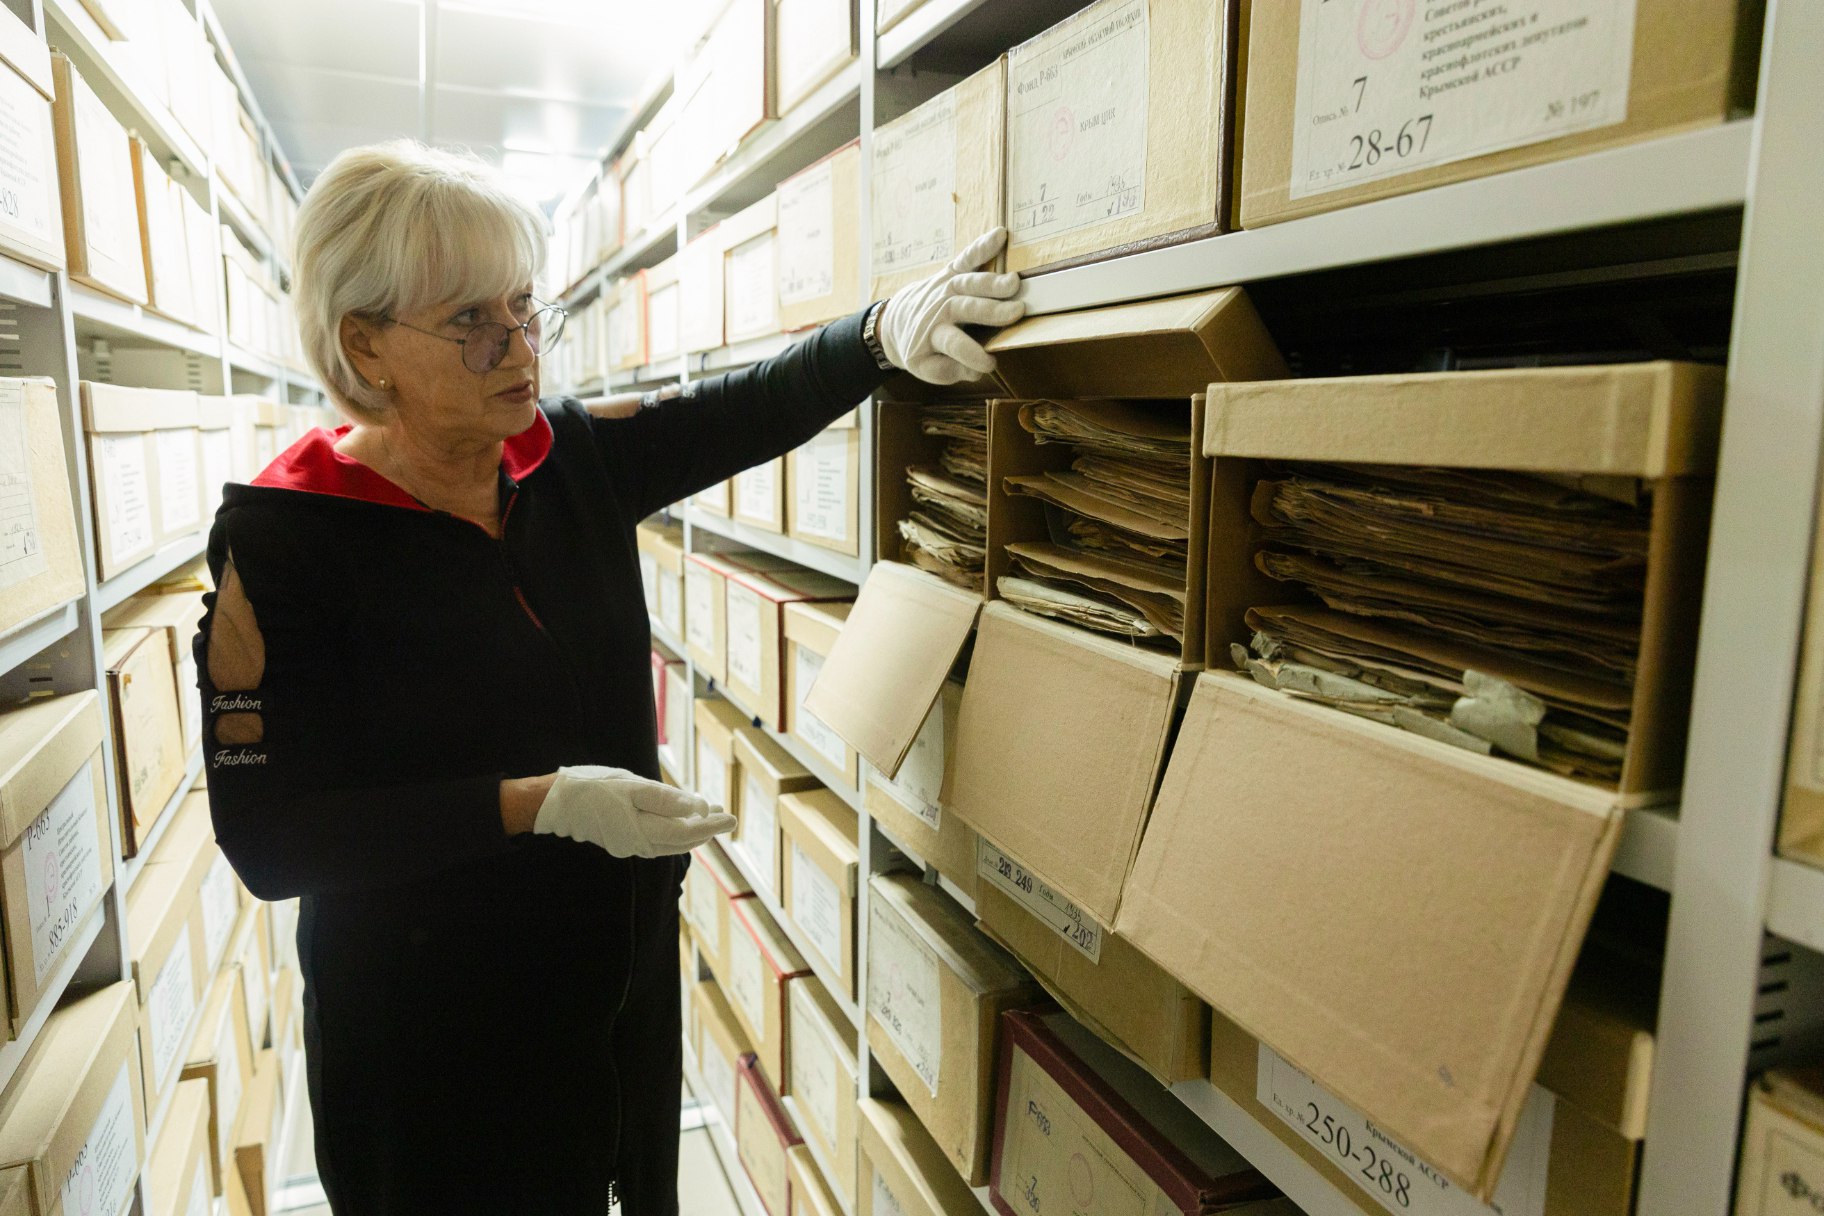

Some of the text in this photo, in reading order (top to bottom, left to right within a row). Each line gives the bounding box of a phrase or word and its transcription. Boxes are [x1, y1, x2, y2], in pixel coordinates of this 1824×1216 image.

[1483, 56, 1521, 78] АССР
[1352, 75, 1368, 113] 7
[1348, 114, 1434, 171] 28-67
[1039, 182, 1047, 202] 7
[210, 693, 262, 713] Fashion
[213, 748, 267, 769] Fashion
[1015, 869, 1033, 894] 249
[48, 896, 78, 954] 885-918
[1305, 1101, 1411, 1208] 250-288
[1365, 1119, 1450, 1190] Крымской АССР
